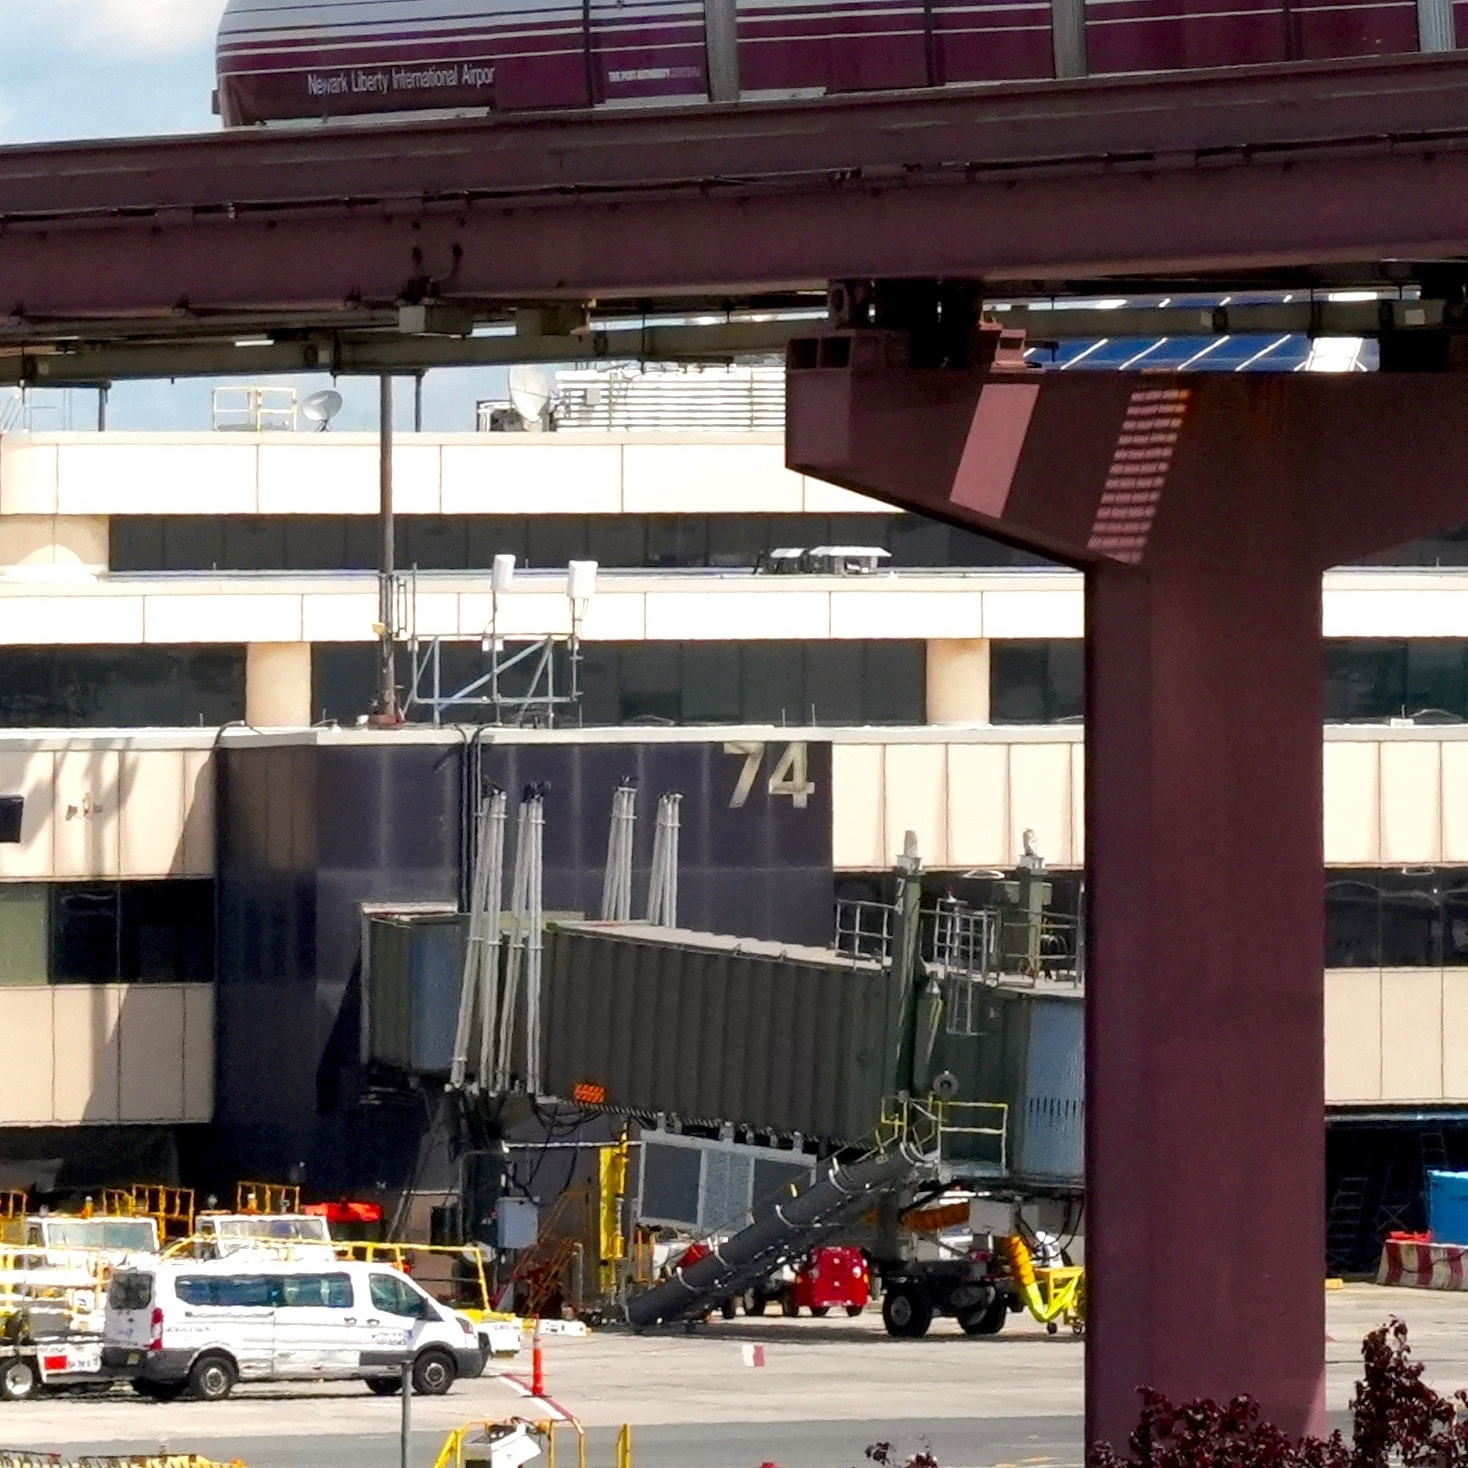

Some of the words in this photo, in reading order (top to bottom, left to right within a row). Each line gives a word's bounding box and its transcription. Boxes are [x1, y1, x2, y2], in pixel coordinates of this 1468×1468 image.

[307, 73, 348, 95] Newark
[351, 70, 390, 94] Liberty
[392, 66, 458, 89] International
[724, 741, 815, 808] 74
